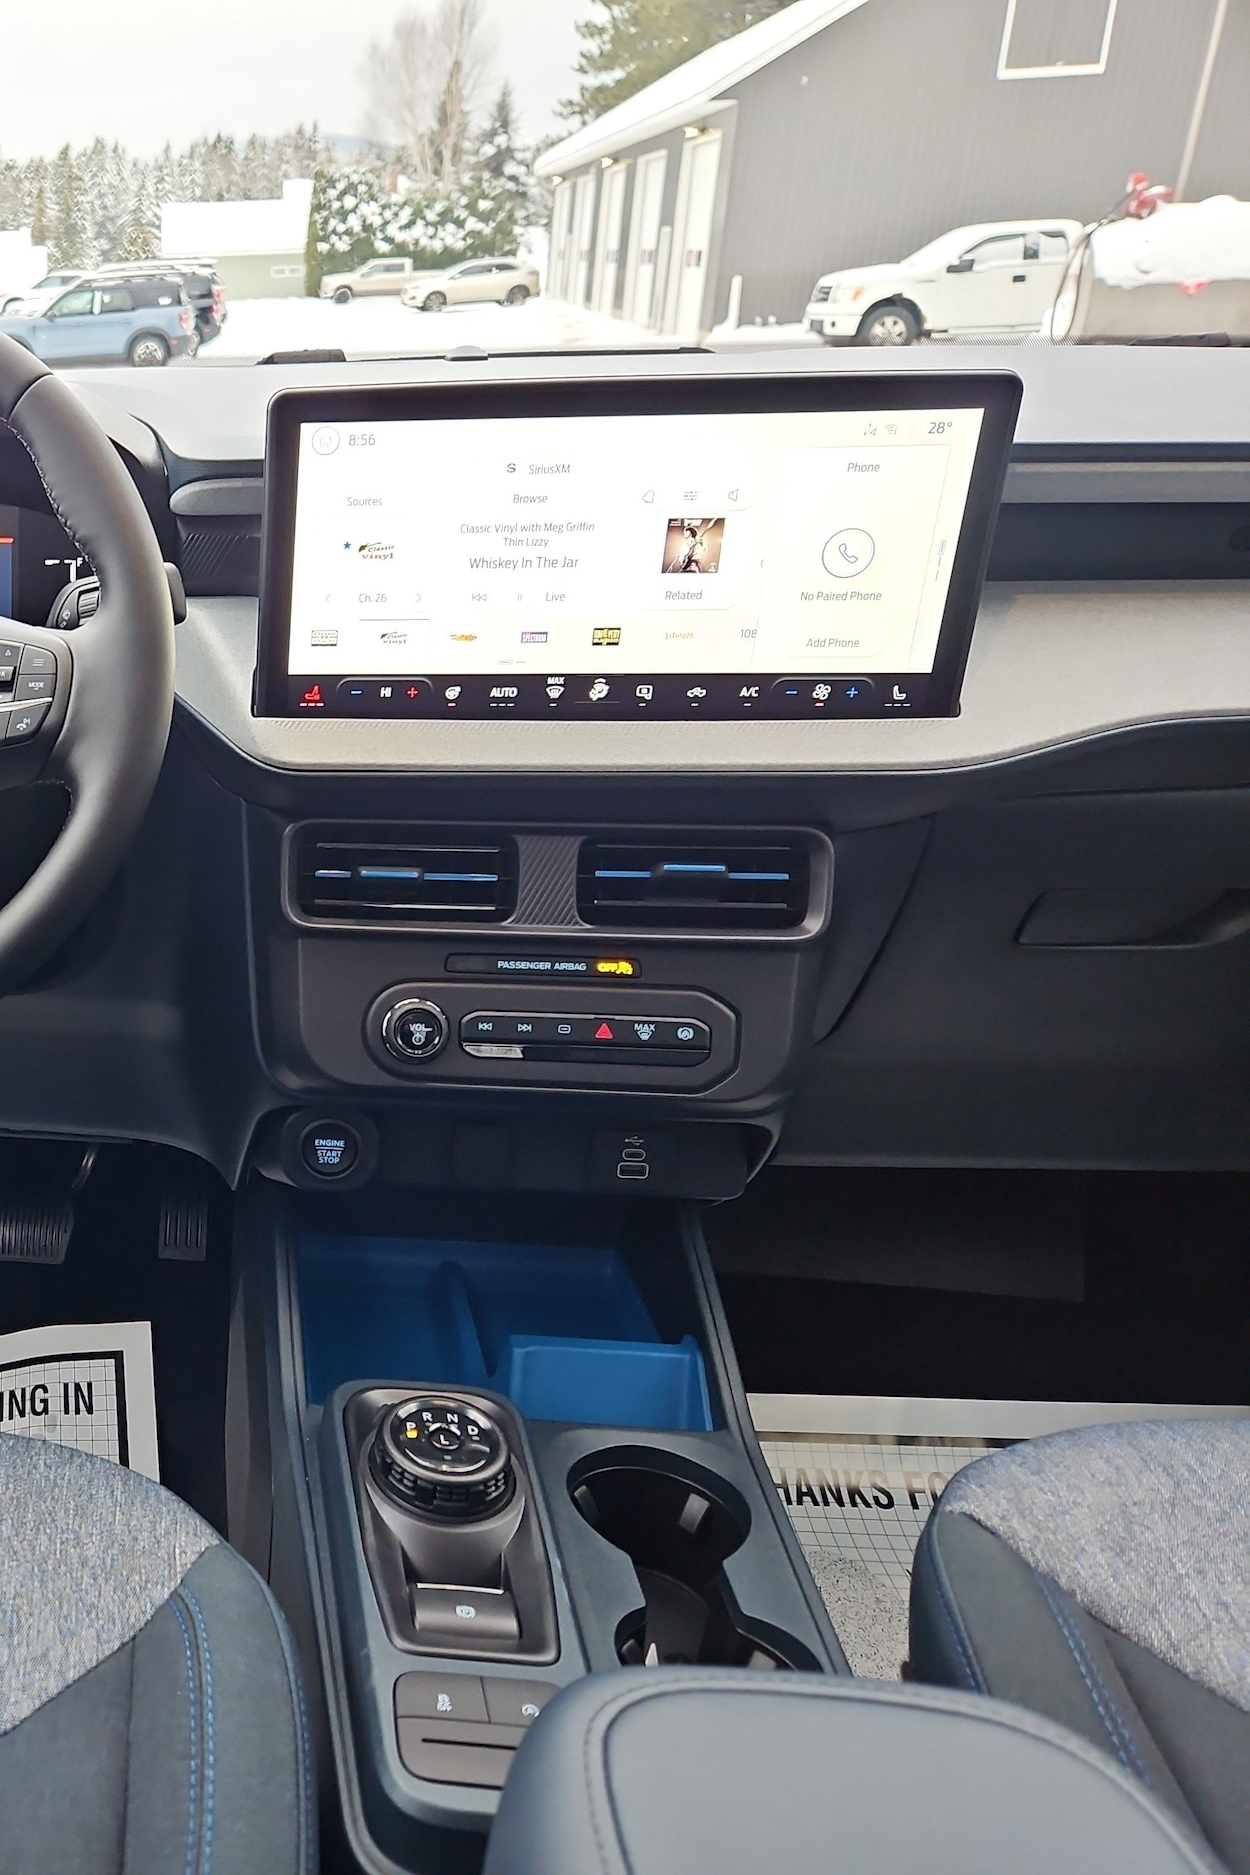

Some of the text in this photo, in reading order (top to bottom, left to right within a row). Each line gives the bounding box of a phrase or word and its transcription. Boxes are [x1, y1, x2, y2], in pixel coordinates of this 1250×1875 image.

[927, 421, 954, 434] 28°
[348, 433, 376, 447] 8:56
[528, 463, 571, 475] SiriusXM
[846, 462, 881, 473] Phone
[347, 496, 383, 507] Sources
[512, 493, 548, 504] Browse
[460, 521, 595, 535] Classic Vinyl with Meg Griffin
[503, 537, 549, 548] Thin Lizzy
[361, 552, 394, 561] vinyl
[469, 556, 579, 571] Whiskey In The Jar
[358, 593, 387, 603] Ch. 26
[545, 592, 565, 602] Live
[665, 589, 702, 600] Related
[800, 591, 882, 602] No Paired Phone
[740, 629, 757, 639] 108
[806, 638, 859, 649] Add Phone
[547, 677, 565, 685] MAX
[380, 687, 392, 697] HI
[490, 687, 518, 697] AUTO
[739, 686, 760, 698] A/C
[497, 960, 551, 970] PASSENGER
[554, 963, 587, 971] AIRBAG
[409, 1023, 426, 1031] VOL
[634, 1023, 656, 1031] MAX
[314, 1139, 346, 1148] ENGINE
[63, 1382, 94, 1415] IN
[422, 1412, 433, 1421] R
[447, 1413, 458, 1423] N
[467, 1425, 479, 1436] D
[439, 1434, 450, 1445] L
[774, 1467, 950, 1510] HANKS FO
